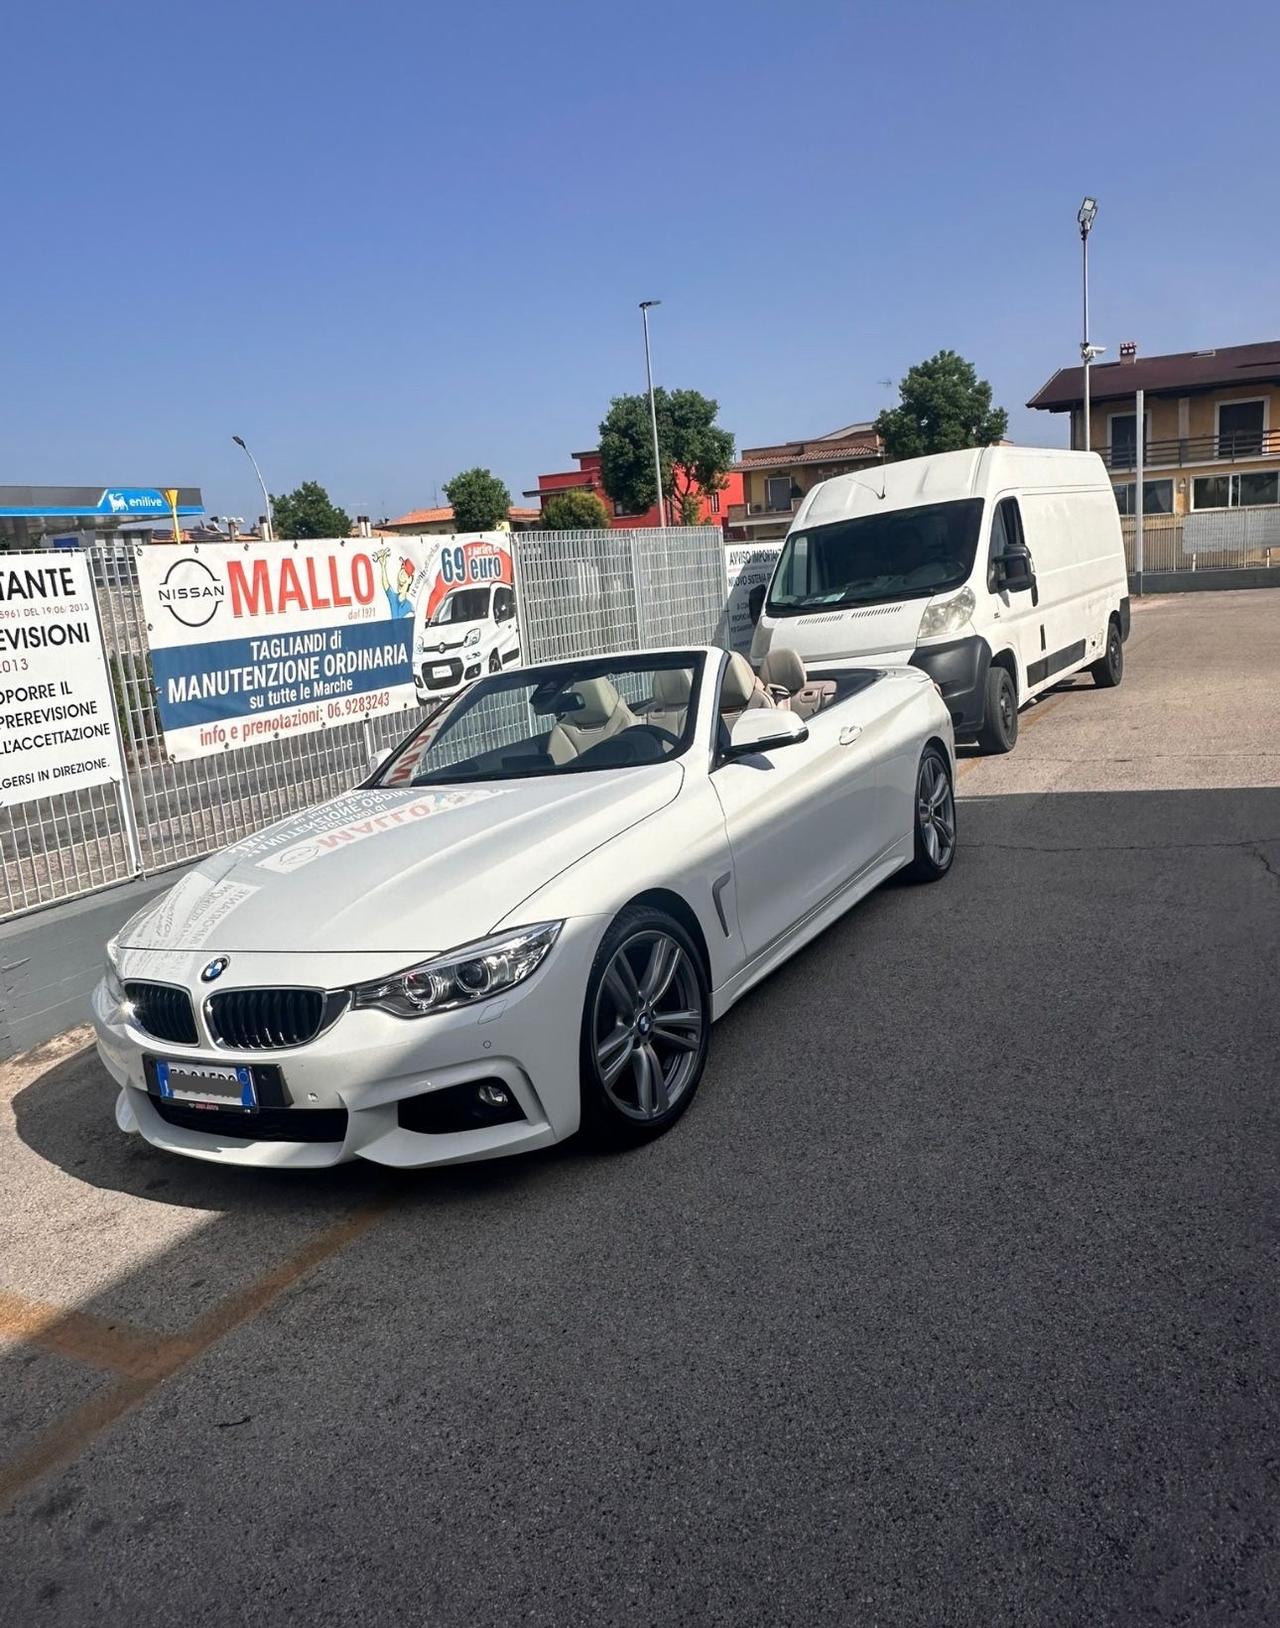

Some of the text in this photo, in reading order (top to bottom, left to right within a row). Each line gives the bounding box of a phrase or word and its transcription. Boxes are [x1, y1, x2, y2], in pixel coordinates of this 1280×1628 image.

[129, 496, 163, 507] enilive
[441, 546, 466, 583] 69
[470, 557, 502, 580] euro
[158, 584, 225, 601] NISSAN
[226, 553, 376, 618] MALLO
[23, 607, 40, 617] DEL
[250, 630, 342, 661] TAGLIANDI di
[0, 657, 29, 673] 013
[167, 643, 409, 704] MANUTENZIONE ORDINARIA
[60, 681, 73, 696] IL
[249, 677, 353, 709] su tutte le Marche
[200, 692, 390, 747] info e prenotazioni: 06.9283243
[0, 757, 110, 790] GERSI IN DIREZIONE.
